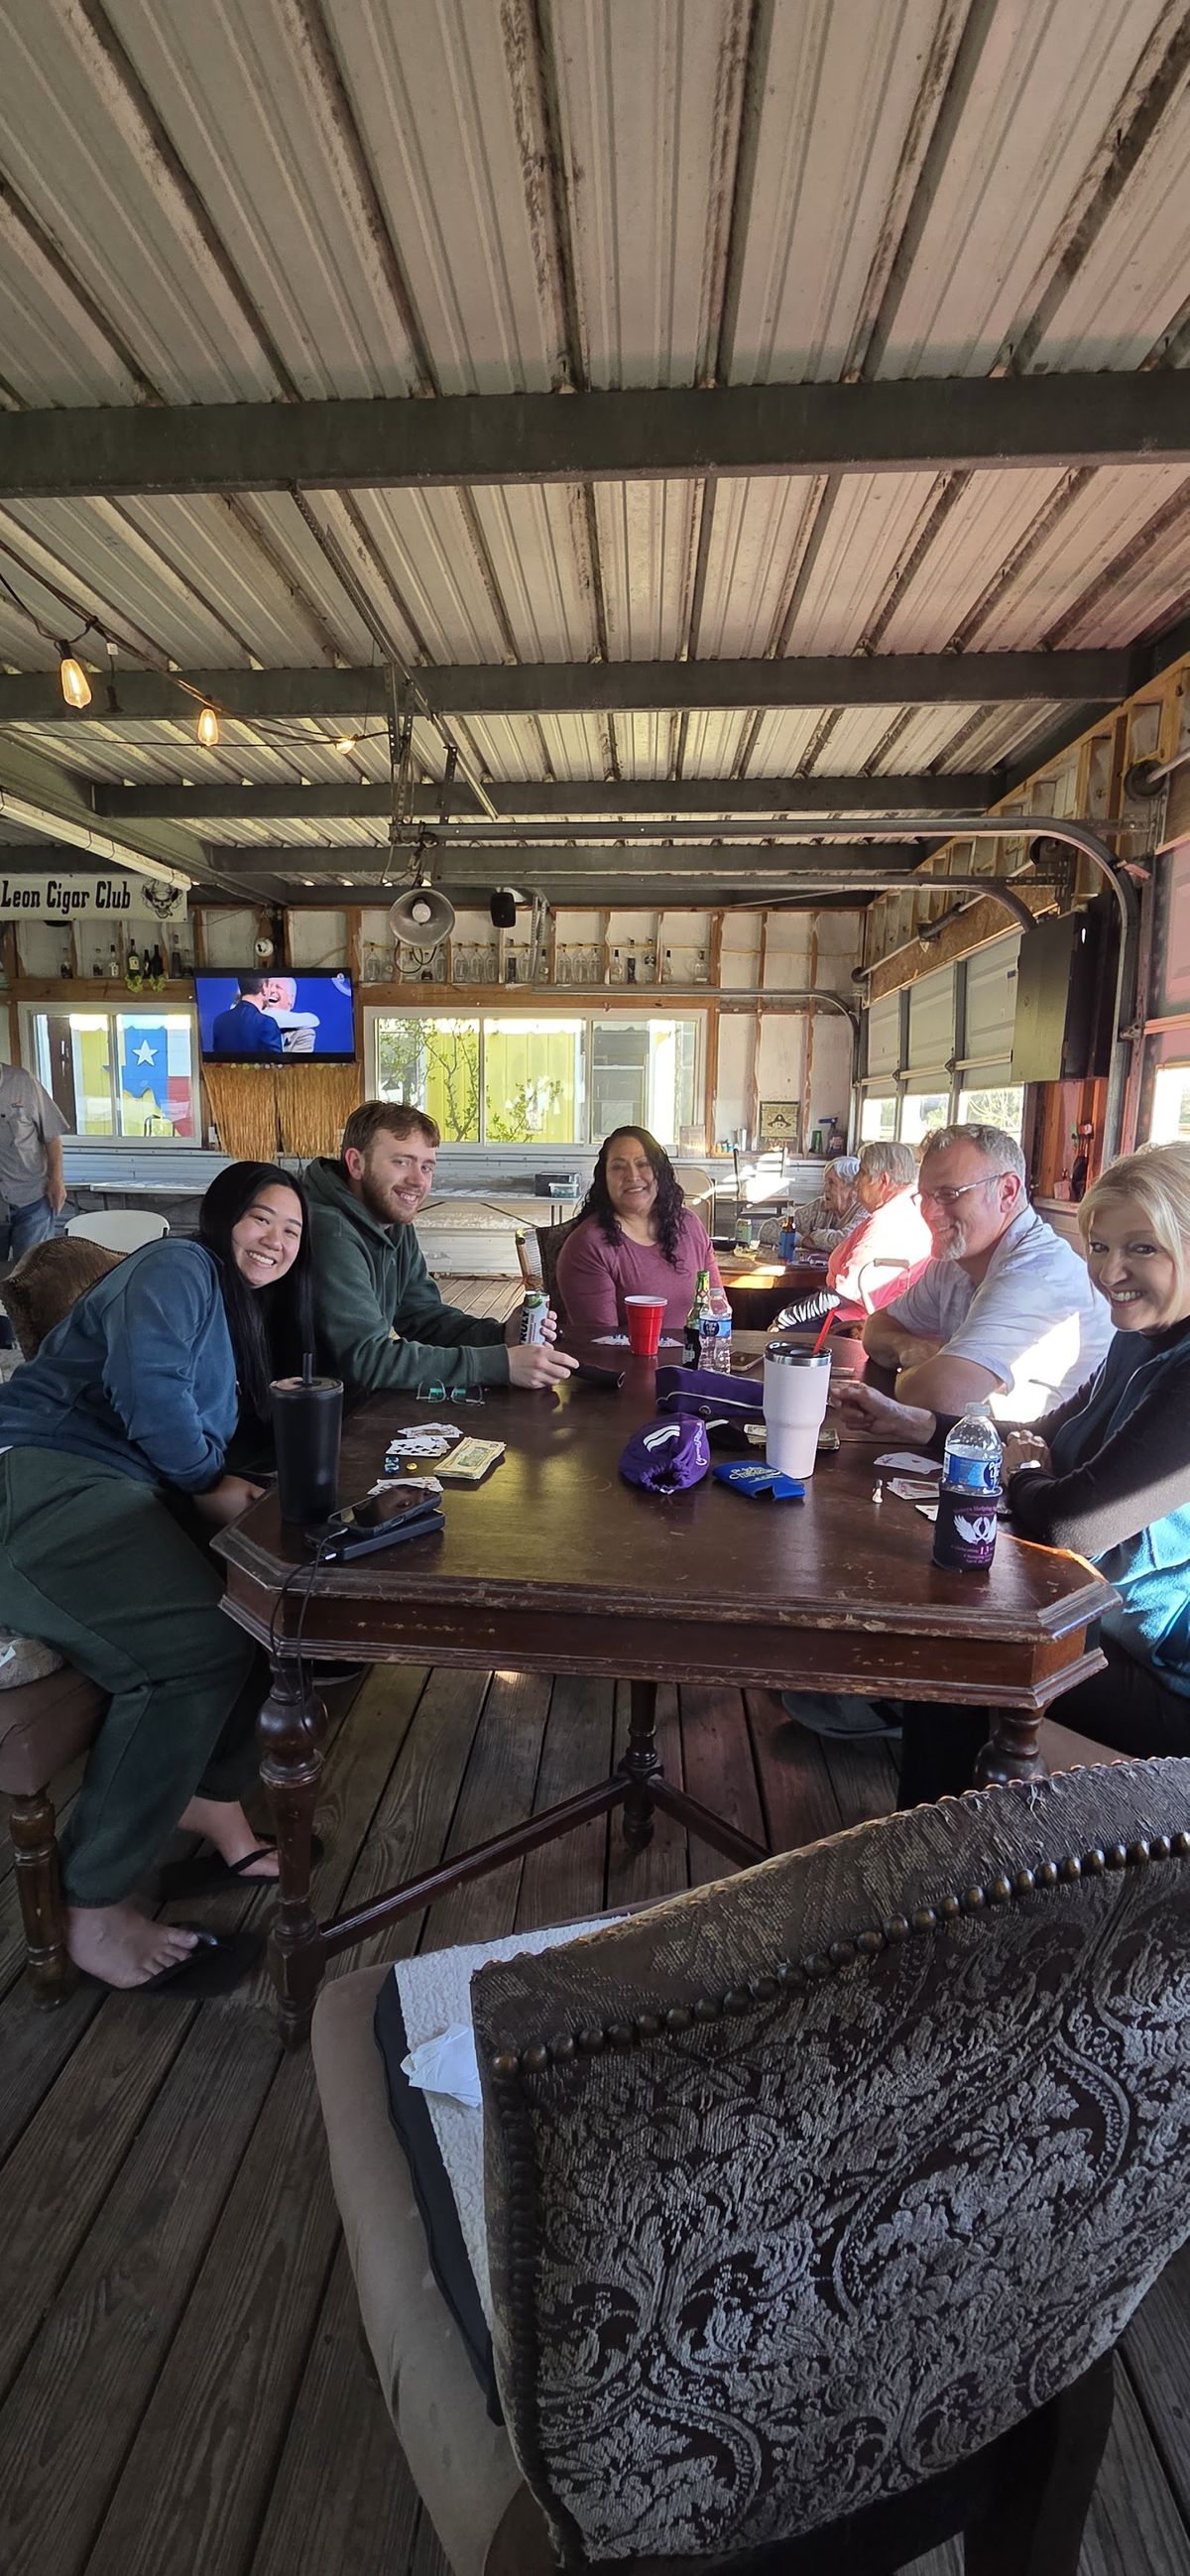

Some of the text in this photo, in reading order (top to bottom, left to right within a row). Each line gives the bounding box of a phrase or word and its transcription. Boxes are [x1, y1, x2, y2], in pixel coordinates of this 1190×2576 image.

[1, 880, 130, 915] Leon Cigar Club
[520, 1310, 530, 1344] RULY
